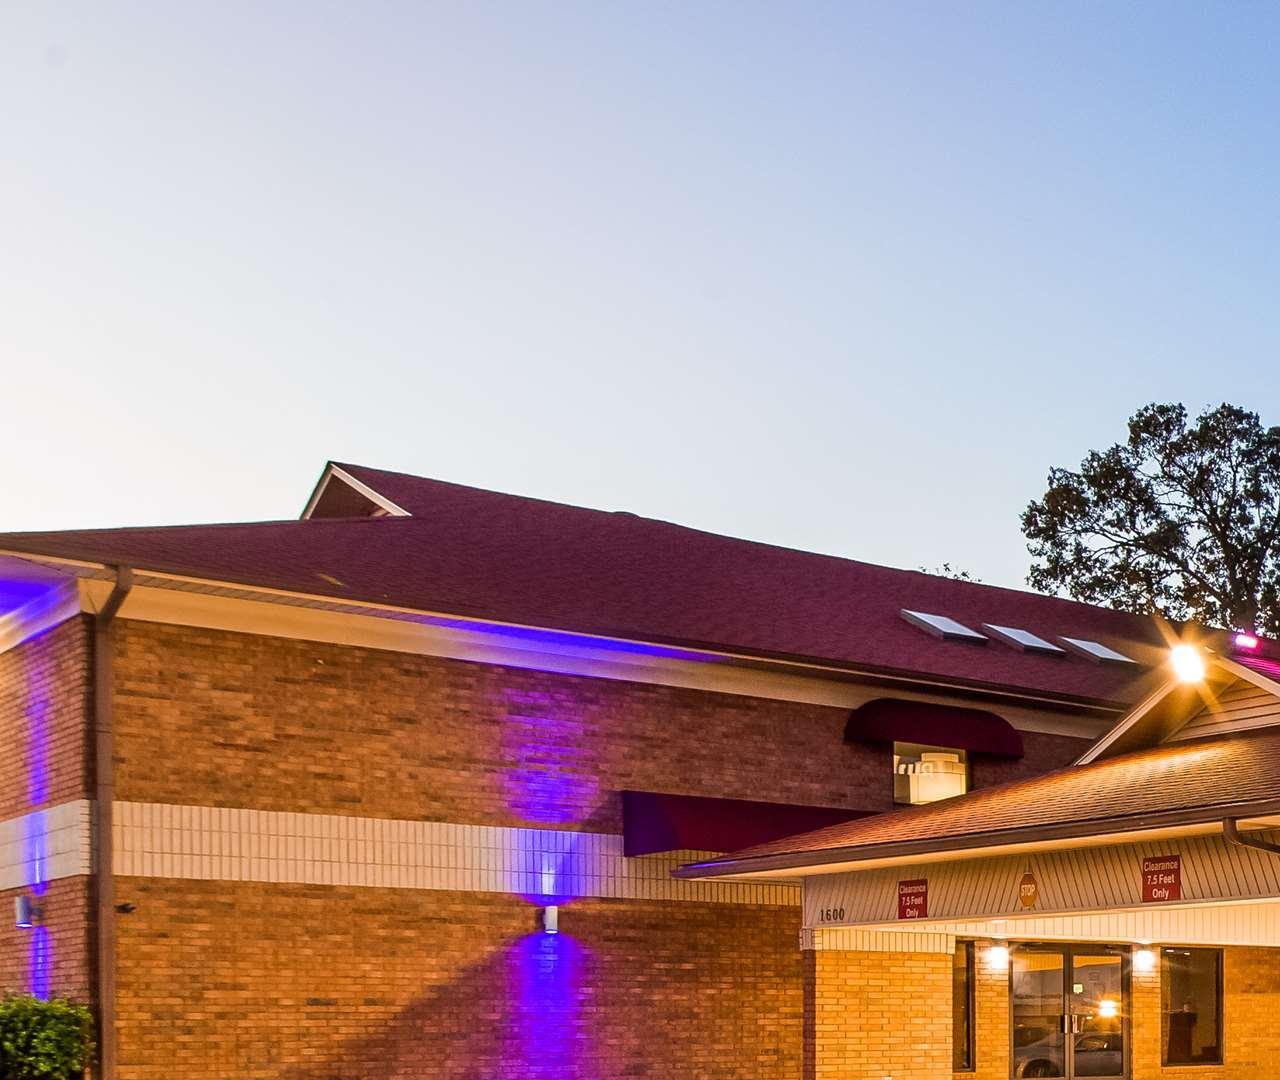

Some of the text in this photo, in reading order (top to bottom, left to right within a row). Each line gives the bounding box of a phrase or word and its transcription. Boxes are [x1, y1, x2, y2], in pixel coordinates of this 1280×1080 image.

[1144, 861, 1179, 871] Clearance
[1147, 873, 1175, 885] 7.5 Feet
[1020, 883, 1036, 897] STOP
[1152, 887, 1170, 900] Only
[819, 908, 845, 922] 1600
